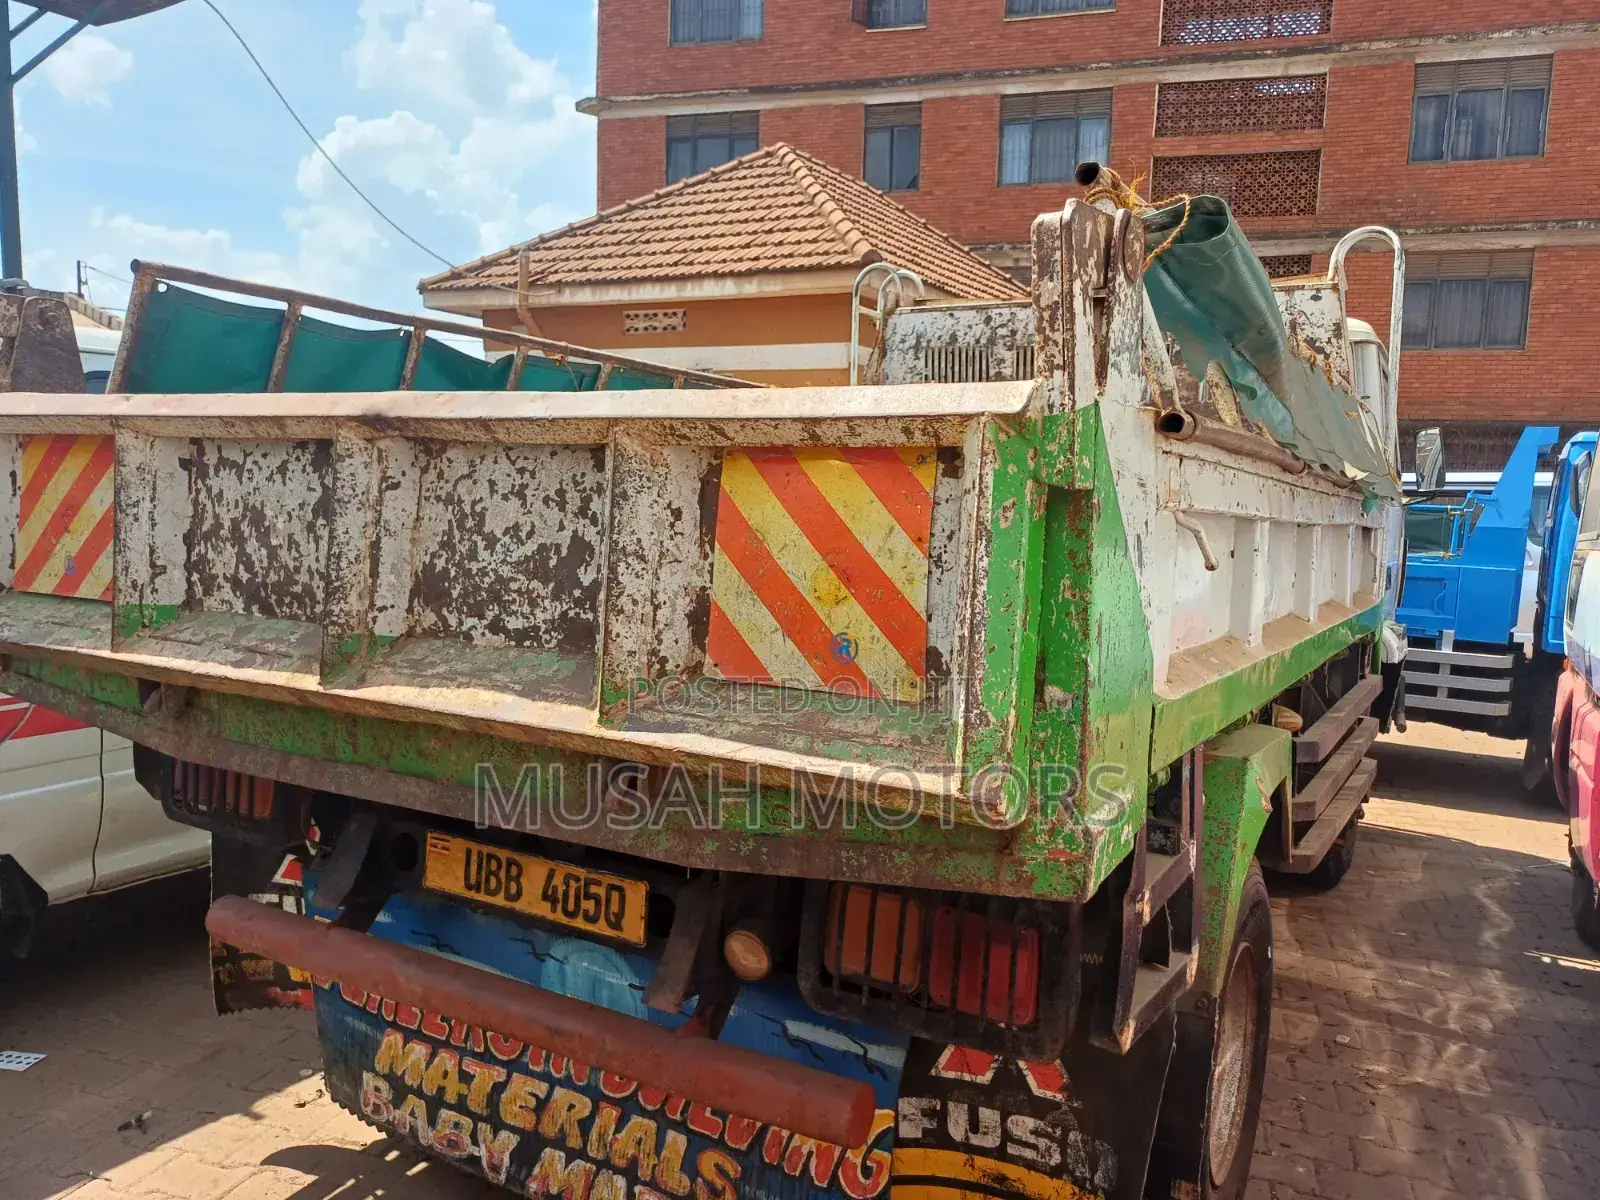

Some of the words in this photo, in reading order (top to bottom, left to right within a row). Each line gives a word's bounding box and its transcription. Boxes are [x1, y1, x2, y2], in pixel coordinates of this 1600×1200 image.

[463, 847, 524, 902] UBB
[541, 867, 627, 932] 405Q
[360, 1070, 521, 1184] BABY
[375, 1028, 742, 1200] MATERIALS
